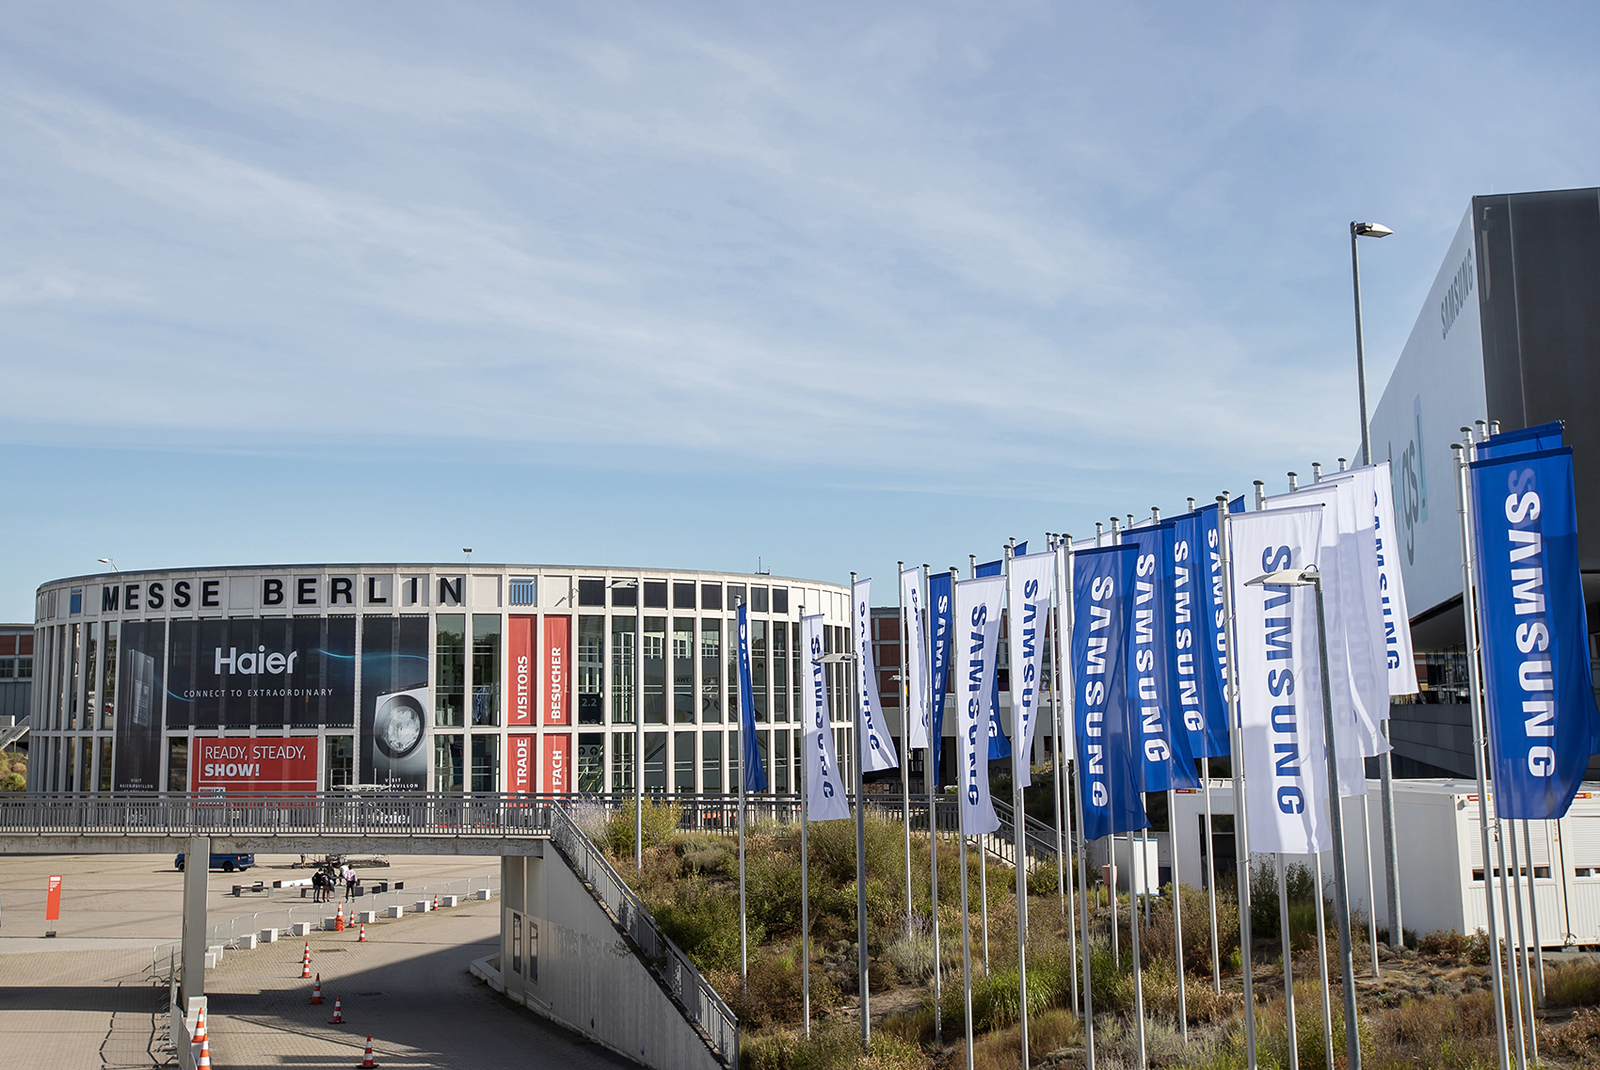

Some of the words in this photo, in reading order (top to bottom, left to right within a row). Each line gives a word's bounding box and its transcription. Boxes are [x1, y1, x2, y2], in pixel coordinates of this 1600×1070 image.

[1441, 248, 1473, 340] SAMSUNG
[102, 580, 219, 612] MESSE
[263, 577, 462, 605] BERLIN
[214, 645, 298, 675] Haier
[1136, 553, 1171, 763] SAMSUNG
[1174, 540, 1204, 732] SAMSUNG
[1505, 491, 1555, 778] SAMSUNG
[183, 689, 226, 698] CONNECT
[230, 689, 242, 697] TO
[247, 688, 333, 697] EXTRAORDINARY
[517, 655, 528, 720] VISITORS
[551, 647, 562, 720] BESUCHER
[582, 698, 597, 707] 2.2
[1085, 575, 1114, 807] SAMSUNG
[1262, 544, 1304, 816] SAMSUNG
[204, 763, 260, 777] SHOW!
[205, 746, 248, 761] READY,
[253, 745, 306, 761] STEADY,
[517, 738, 528, 786] TRADE
[552, 750, 562, 786] FACH
